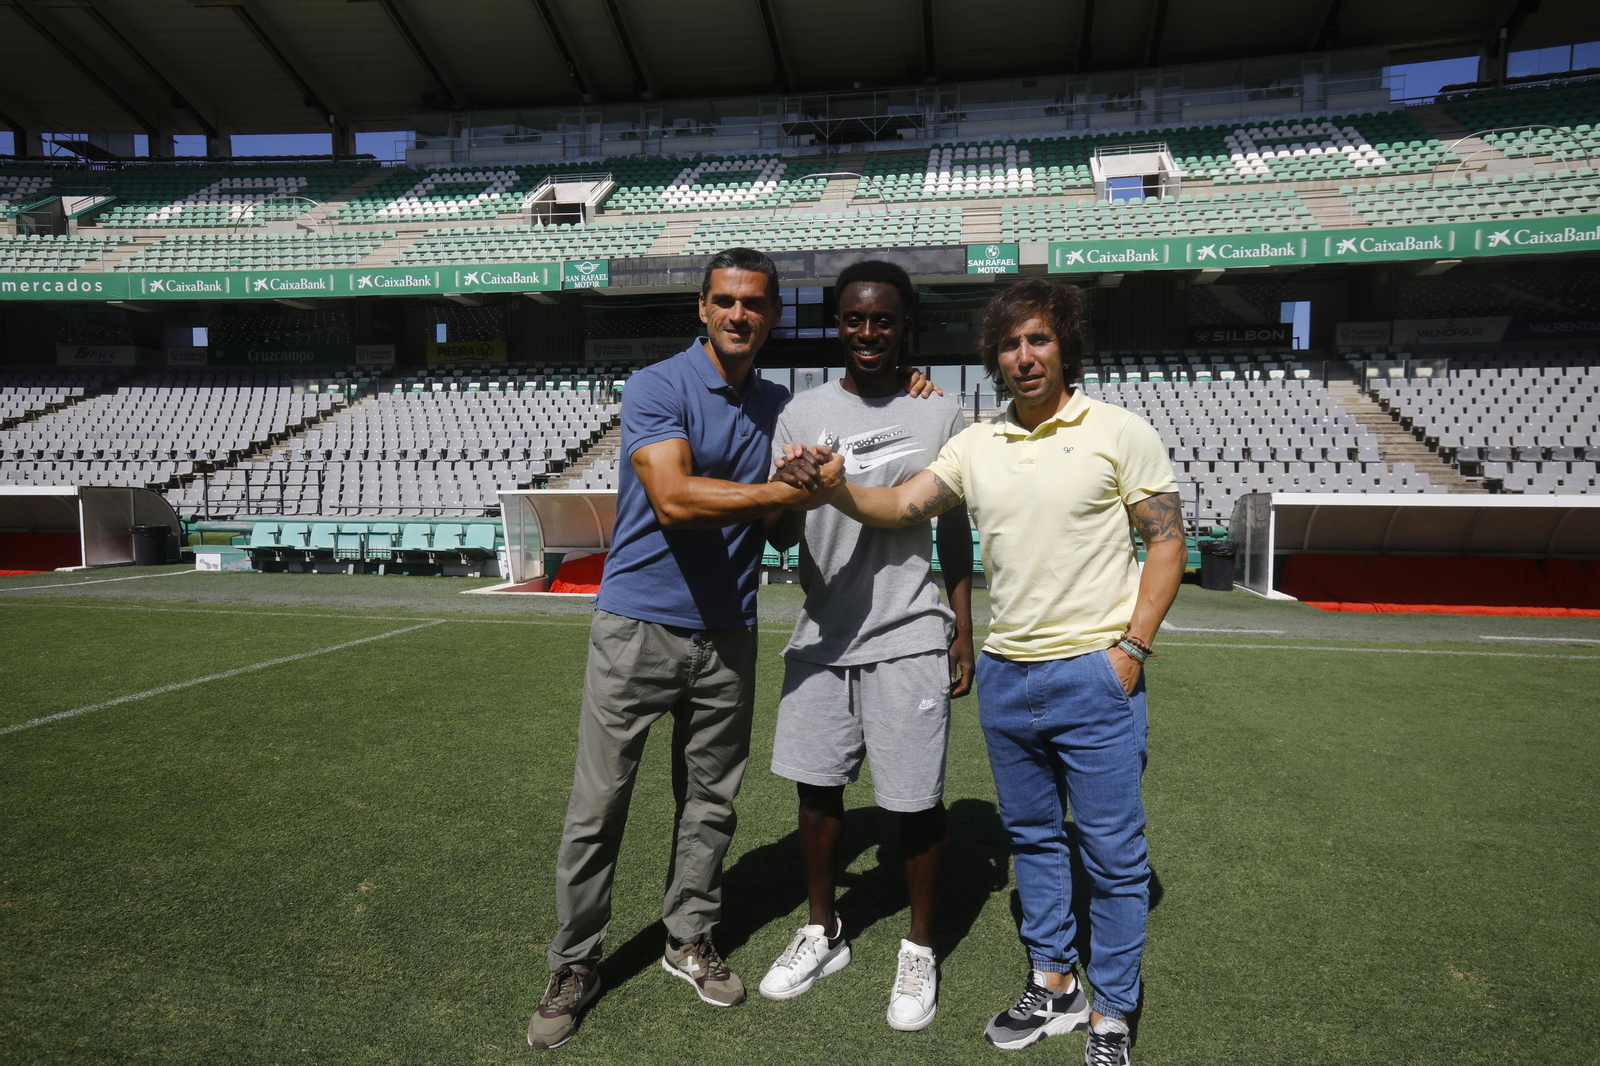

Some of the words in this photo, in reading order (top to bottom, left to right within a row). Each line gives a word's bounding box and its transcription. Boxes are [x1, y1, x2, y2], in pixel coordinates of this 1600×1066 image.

[1218, 241, 1296, 259] CaixaBank
[1360, 235, 1443, 253] CaixaBank
[968, 259, 985, 267] SAN
[985, 258, 1016, 266] RAFAEL
[1086, 248, 1159, 264] CaixaBank
[580, 273, 609, 281] RAFAEL
[977, 266, 1006, 274] MOTOR
[1, 278, 104, 292] mercados
[269, 277, 327, 291] CaixaBank
[374, 274, 432, 288] CaixaBank
[480, 271, 540, 286] CaixaBank
[166, 280, 223, 293] CaixaBank
[1213, 329, 1286, 342] SILBON
[1417, 328, 1483, 338] VALMOPSUR
[89, 350, 118, 359] PACC
[247, 349, 314, 364] Cruzcampo
